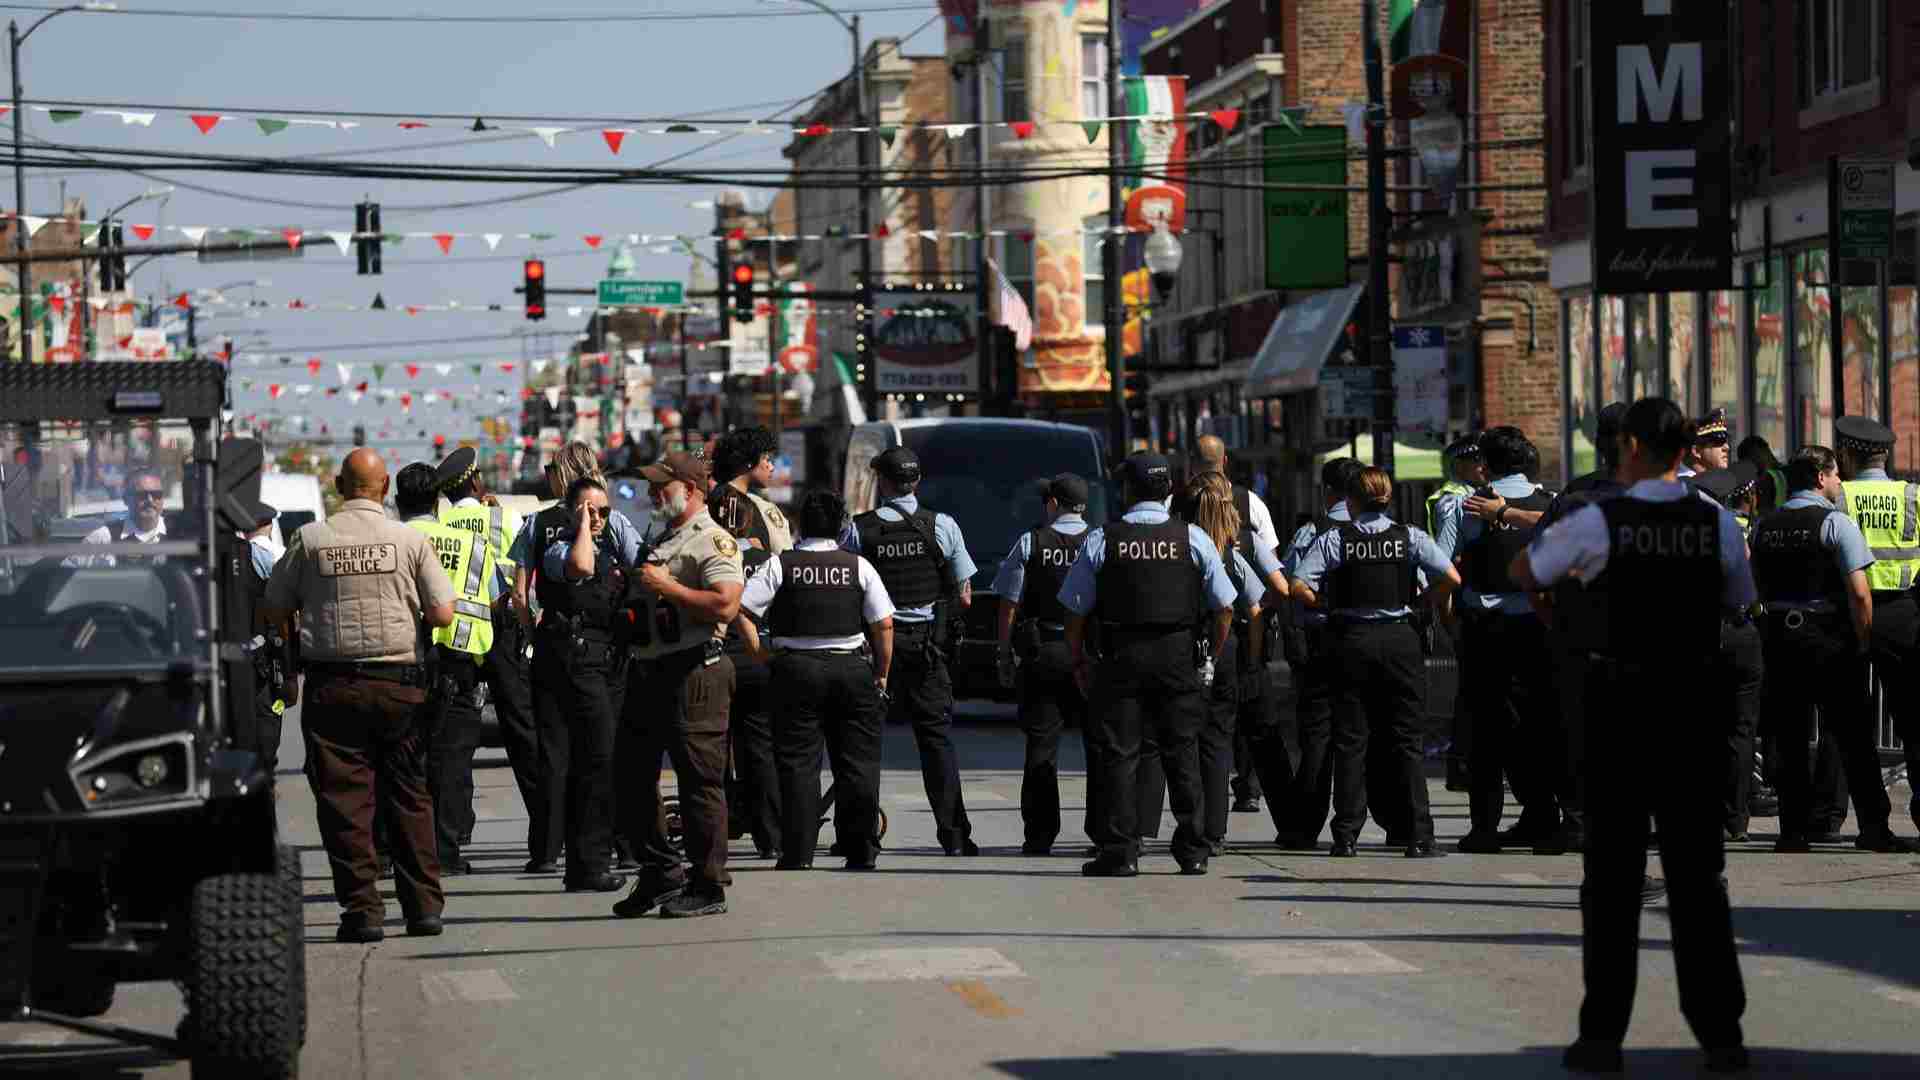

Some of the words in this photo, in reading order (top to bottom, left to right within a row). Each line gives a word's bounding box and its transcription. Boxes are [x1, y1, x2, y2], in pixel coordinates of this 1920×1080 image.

[1615, 0, 1704, 230] ME
[1855, 495, 1898, 512] CHICAGO
[1857, 512, 1898, 530] POLICE
[1616, 524, 1713, 558] POLICE
[1763, 528, 1812, 548] POLICE
[326, 545, 388, 561] SHERIFF'S
[877, 542, 925, 558] POLICE
[1119, 541, 1179, 561] POLICE
[1345, 540, 1404, 561] POLICE
[334, 559, 381, 573] POLICE
[792, 567, 850, 585] POLICE
